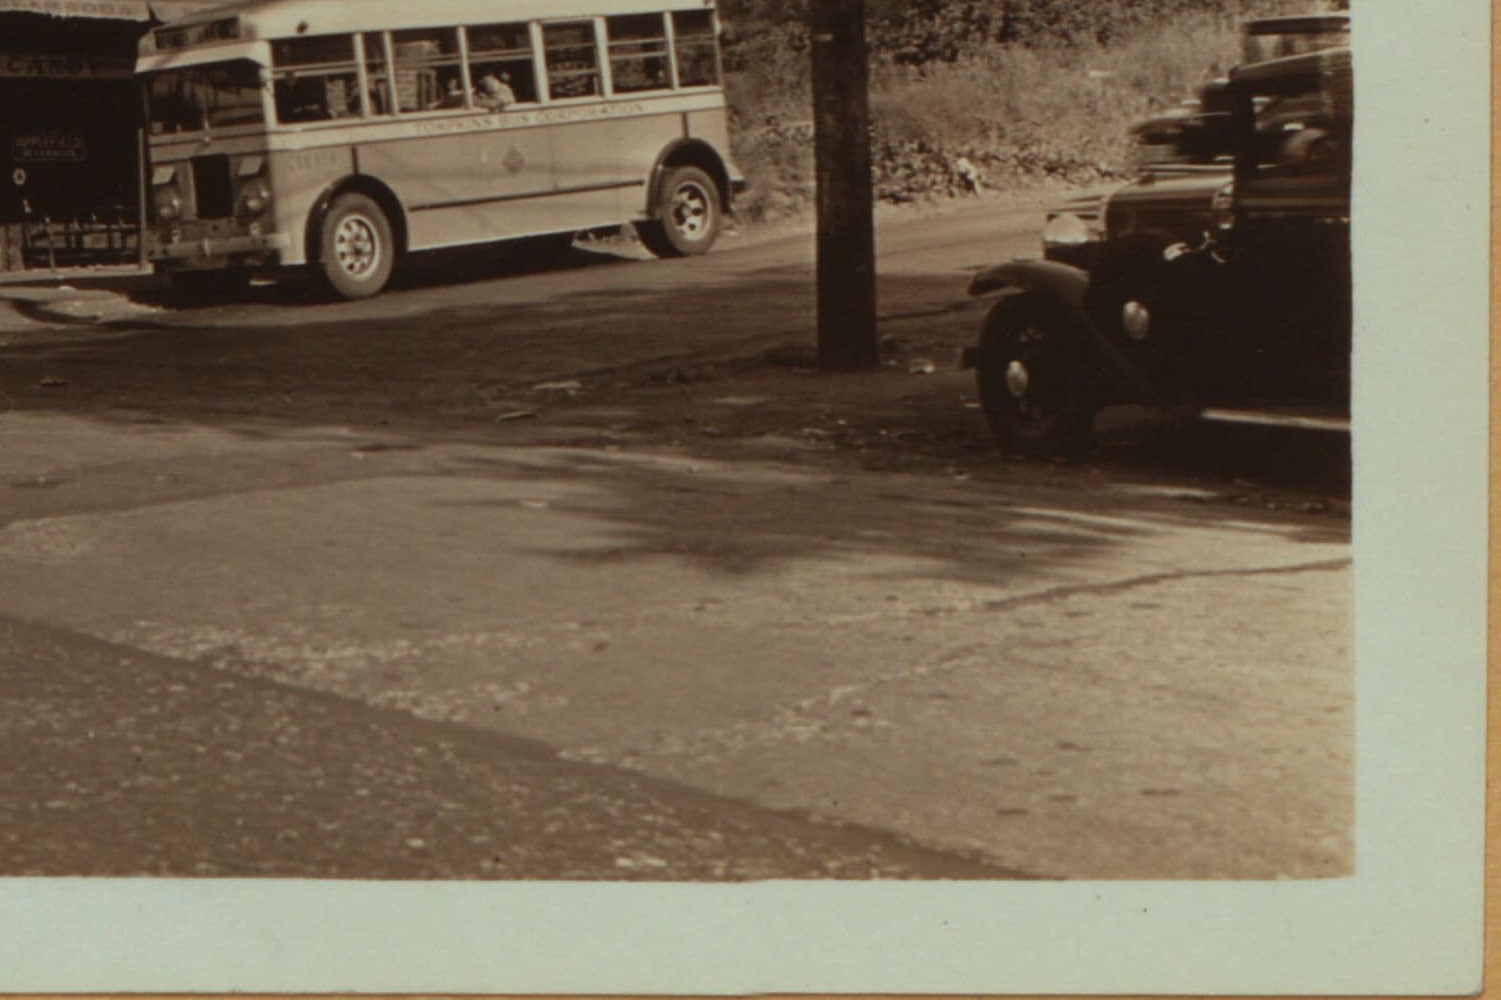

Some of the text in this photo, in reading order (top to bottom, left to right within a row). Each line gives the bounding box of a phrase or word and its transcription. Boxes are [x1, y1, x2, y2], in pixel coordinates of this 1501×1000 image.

[5, 56, 104, 77] CANDY
[498, 114, 531, 127] BUS
[535, 101, 645, 124] CORPORATION
